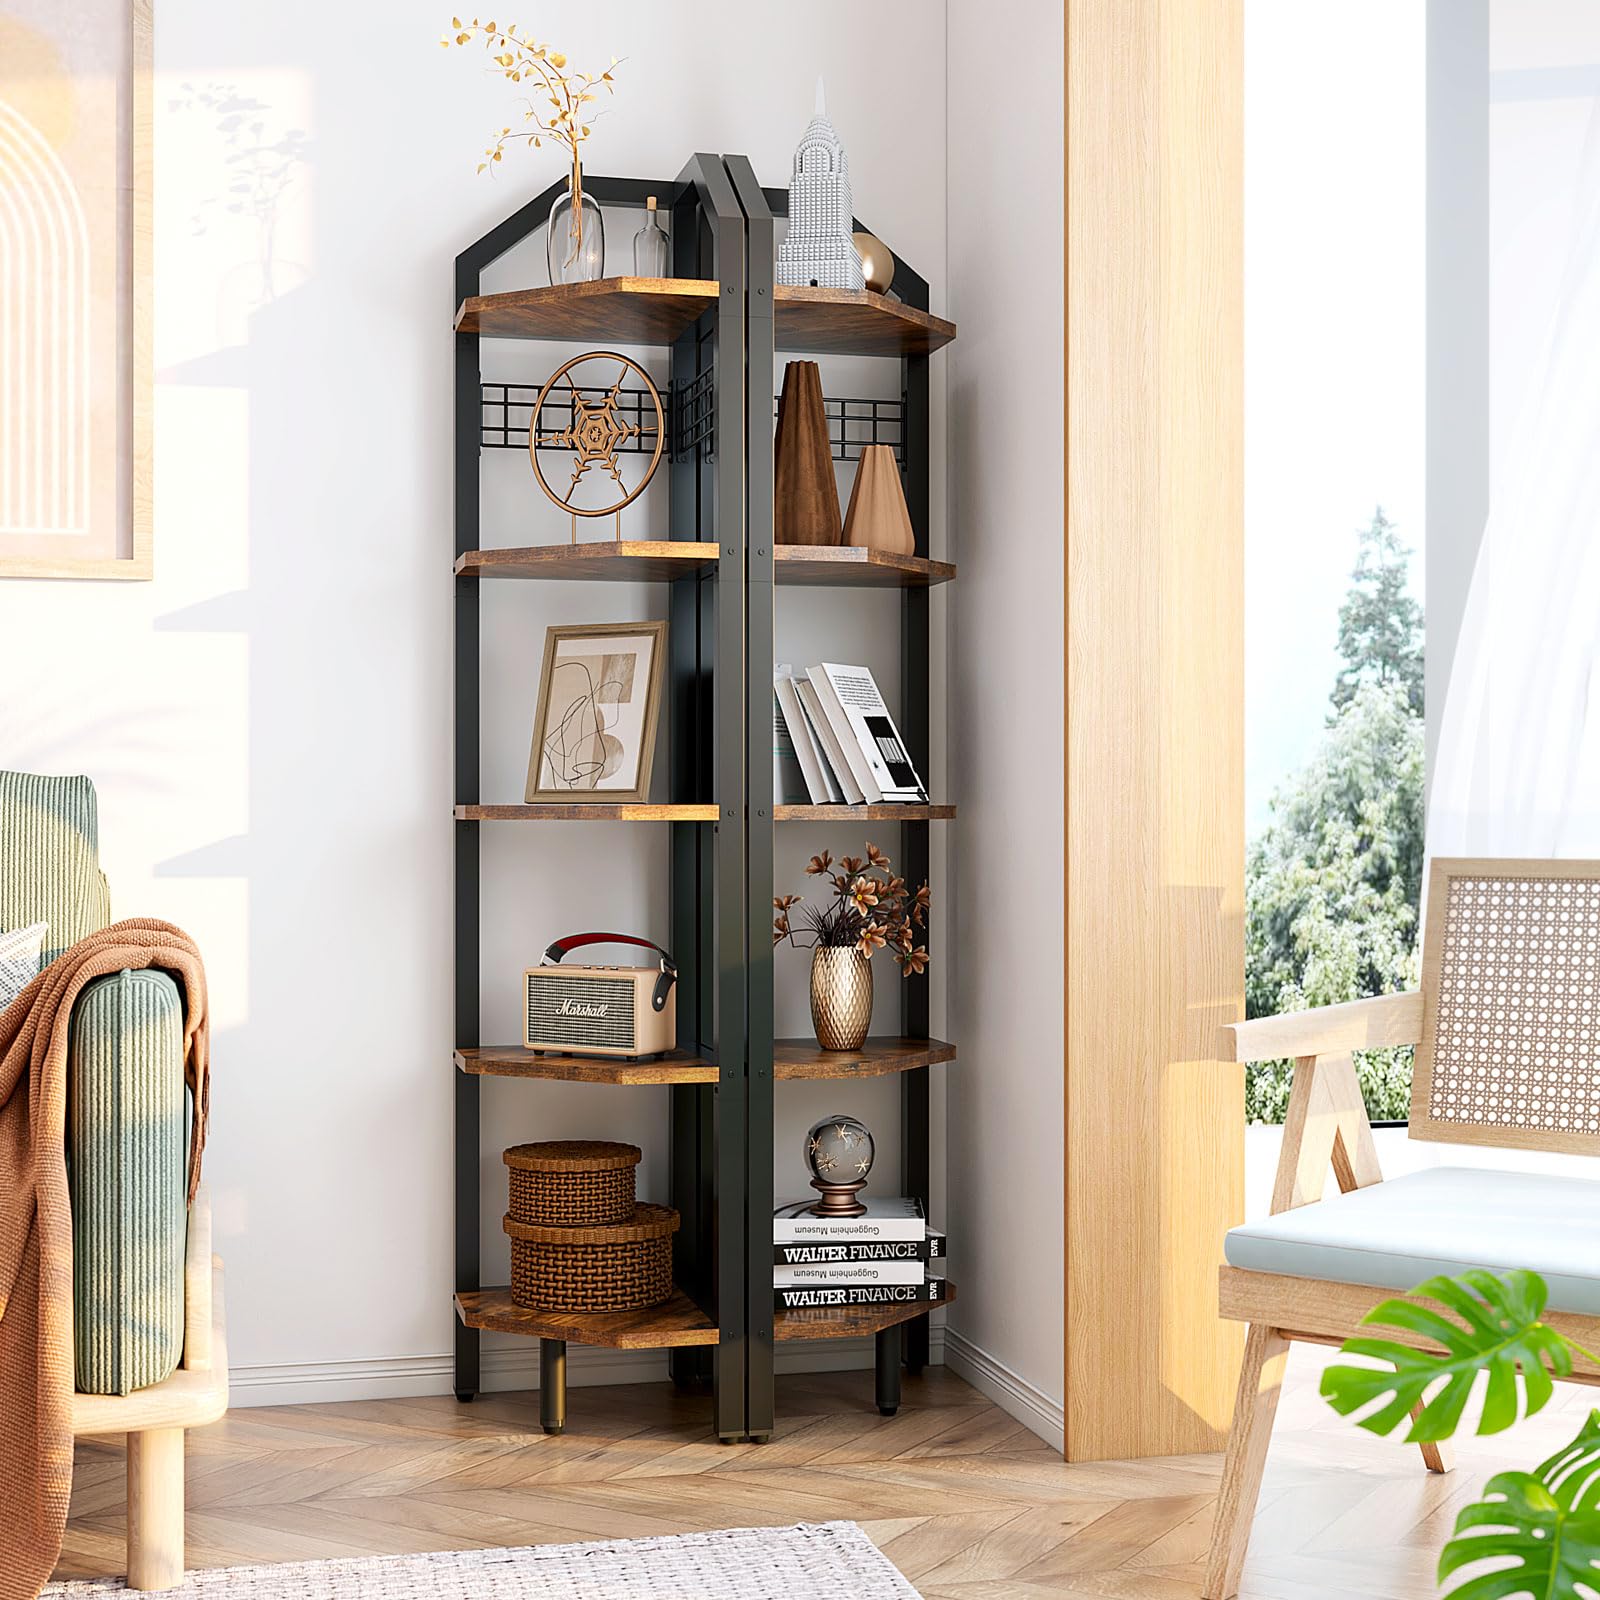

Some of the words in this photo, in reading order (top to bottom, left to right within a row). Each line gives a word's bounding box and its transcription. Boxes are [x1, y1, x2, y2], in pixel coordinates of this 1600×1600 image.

[555, 998, 609, 1017] Marshall
[794, 1227, 828, 1235] Museum
[830, 1226, 880, 1235] Guggenheim
[783, 1245, 848, 1263] WALTER
[849, 1242, 918, 1259] FINANCE
[930, 1239, 939, 1257] EVR
[793, 1270, 827, 1278] Museum
[829, 1269, 879, 1279] Guggenheim
[782, 1289, 847, 1307] WALTER
[848, 1286, 917, 1303] FINANCE
[929, 1282, 938, 1300] EVR
